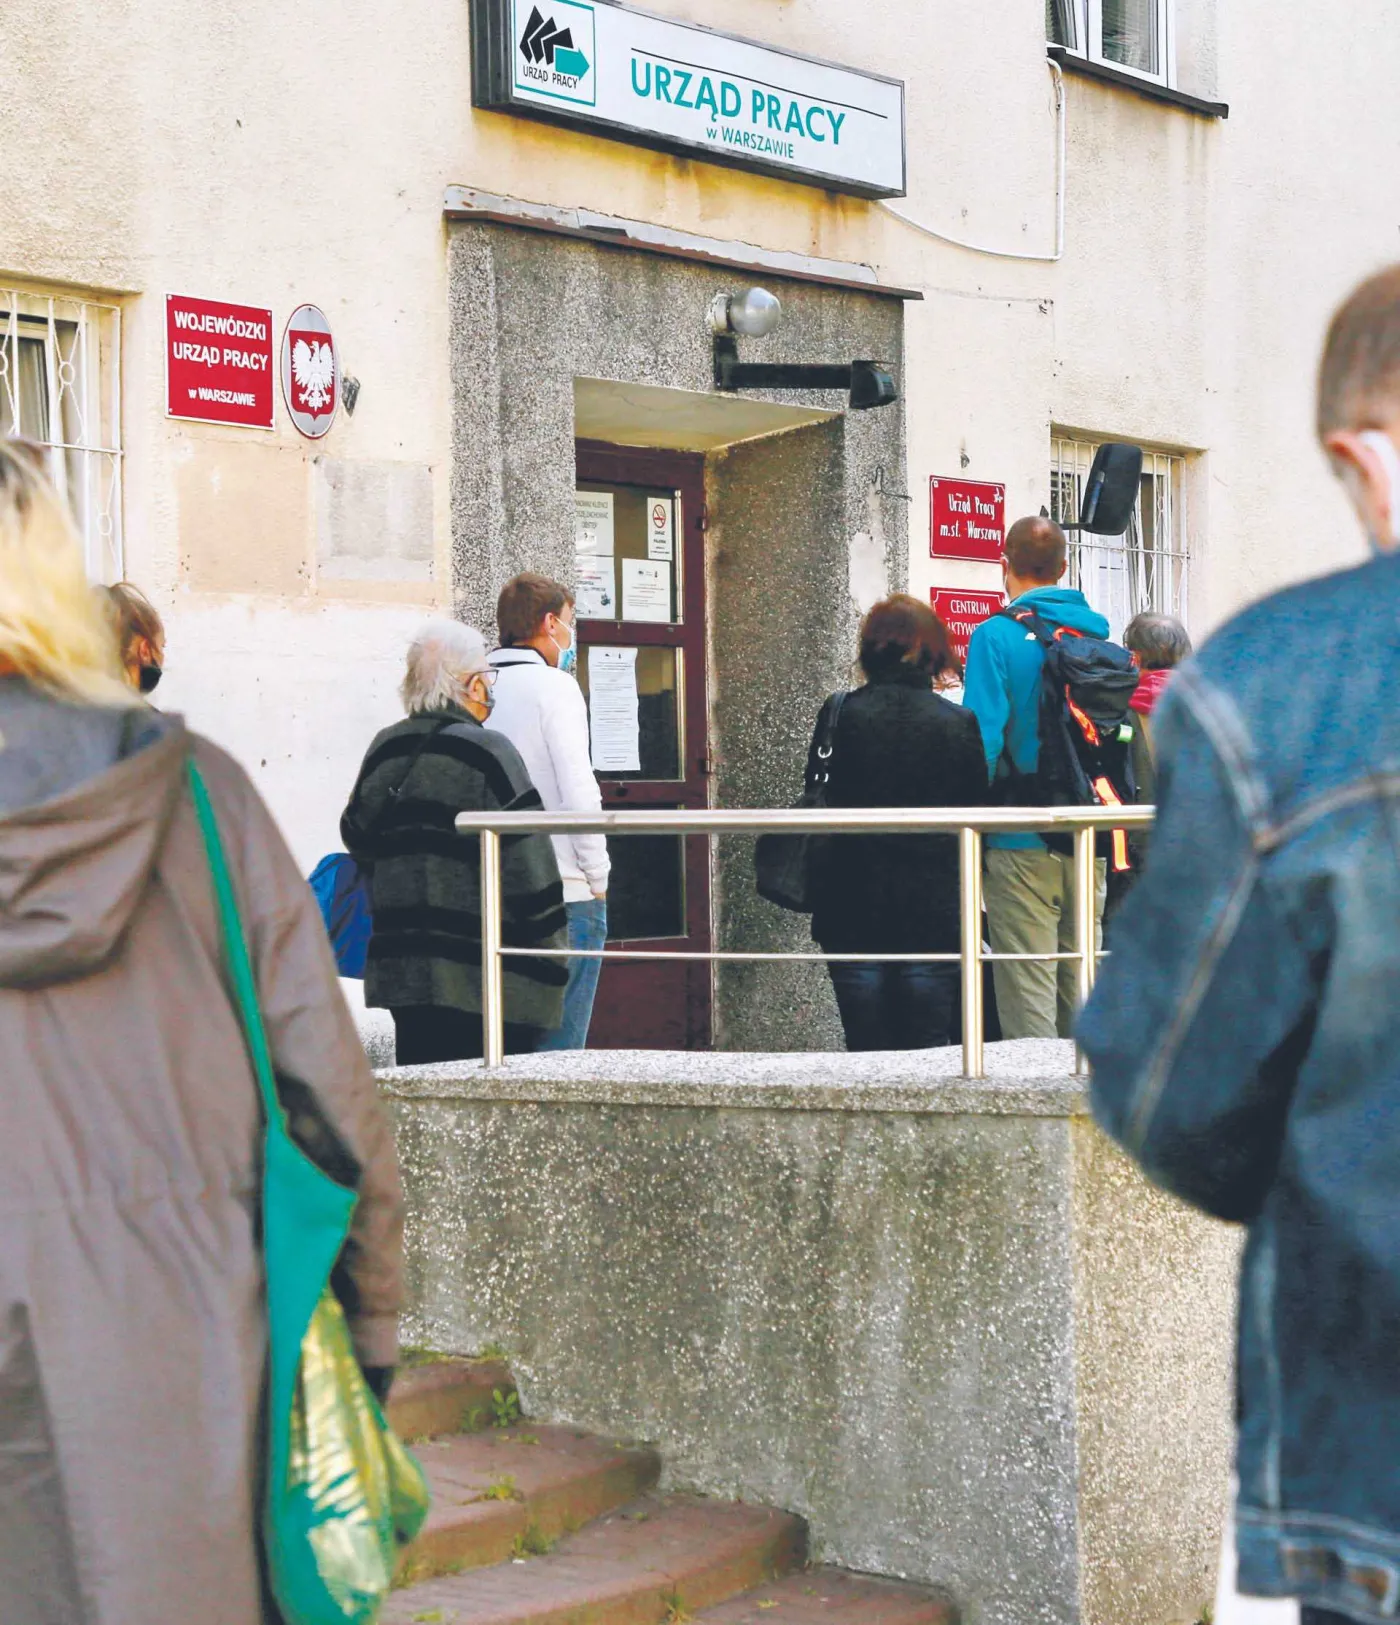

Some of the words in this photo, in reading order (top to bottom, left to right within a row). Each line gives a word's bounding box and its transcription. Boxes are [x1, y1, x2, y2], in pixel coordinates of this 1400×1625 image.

[522, 65, 549, 84] URZĄD
[552, 72, 578, 89] PRACY
[631, 57, 742, 123] URZĄD
[751, 88, 846, 145] PRACY
[706, 126, 718, 140] w
[721, 126, 794, 159] WARSZAWIE
[174, 310, 266, 341] WOJEWÓDZKI
[172, 342, 220, 367] URZĄD
[223, 349, 268, 371] PRACY
[198, 387, 256, 407] WARSZAWIE
[948, 493, 972, 515] Urząd
[974, 496, 995, 521] Pracy
[967, 520, 1002, 547] Warszawy
[950, 600, 990, 616] CENTRUM
